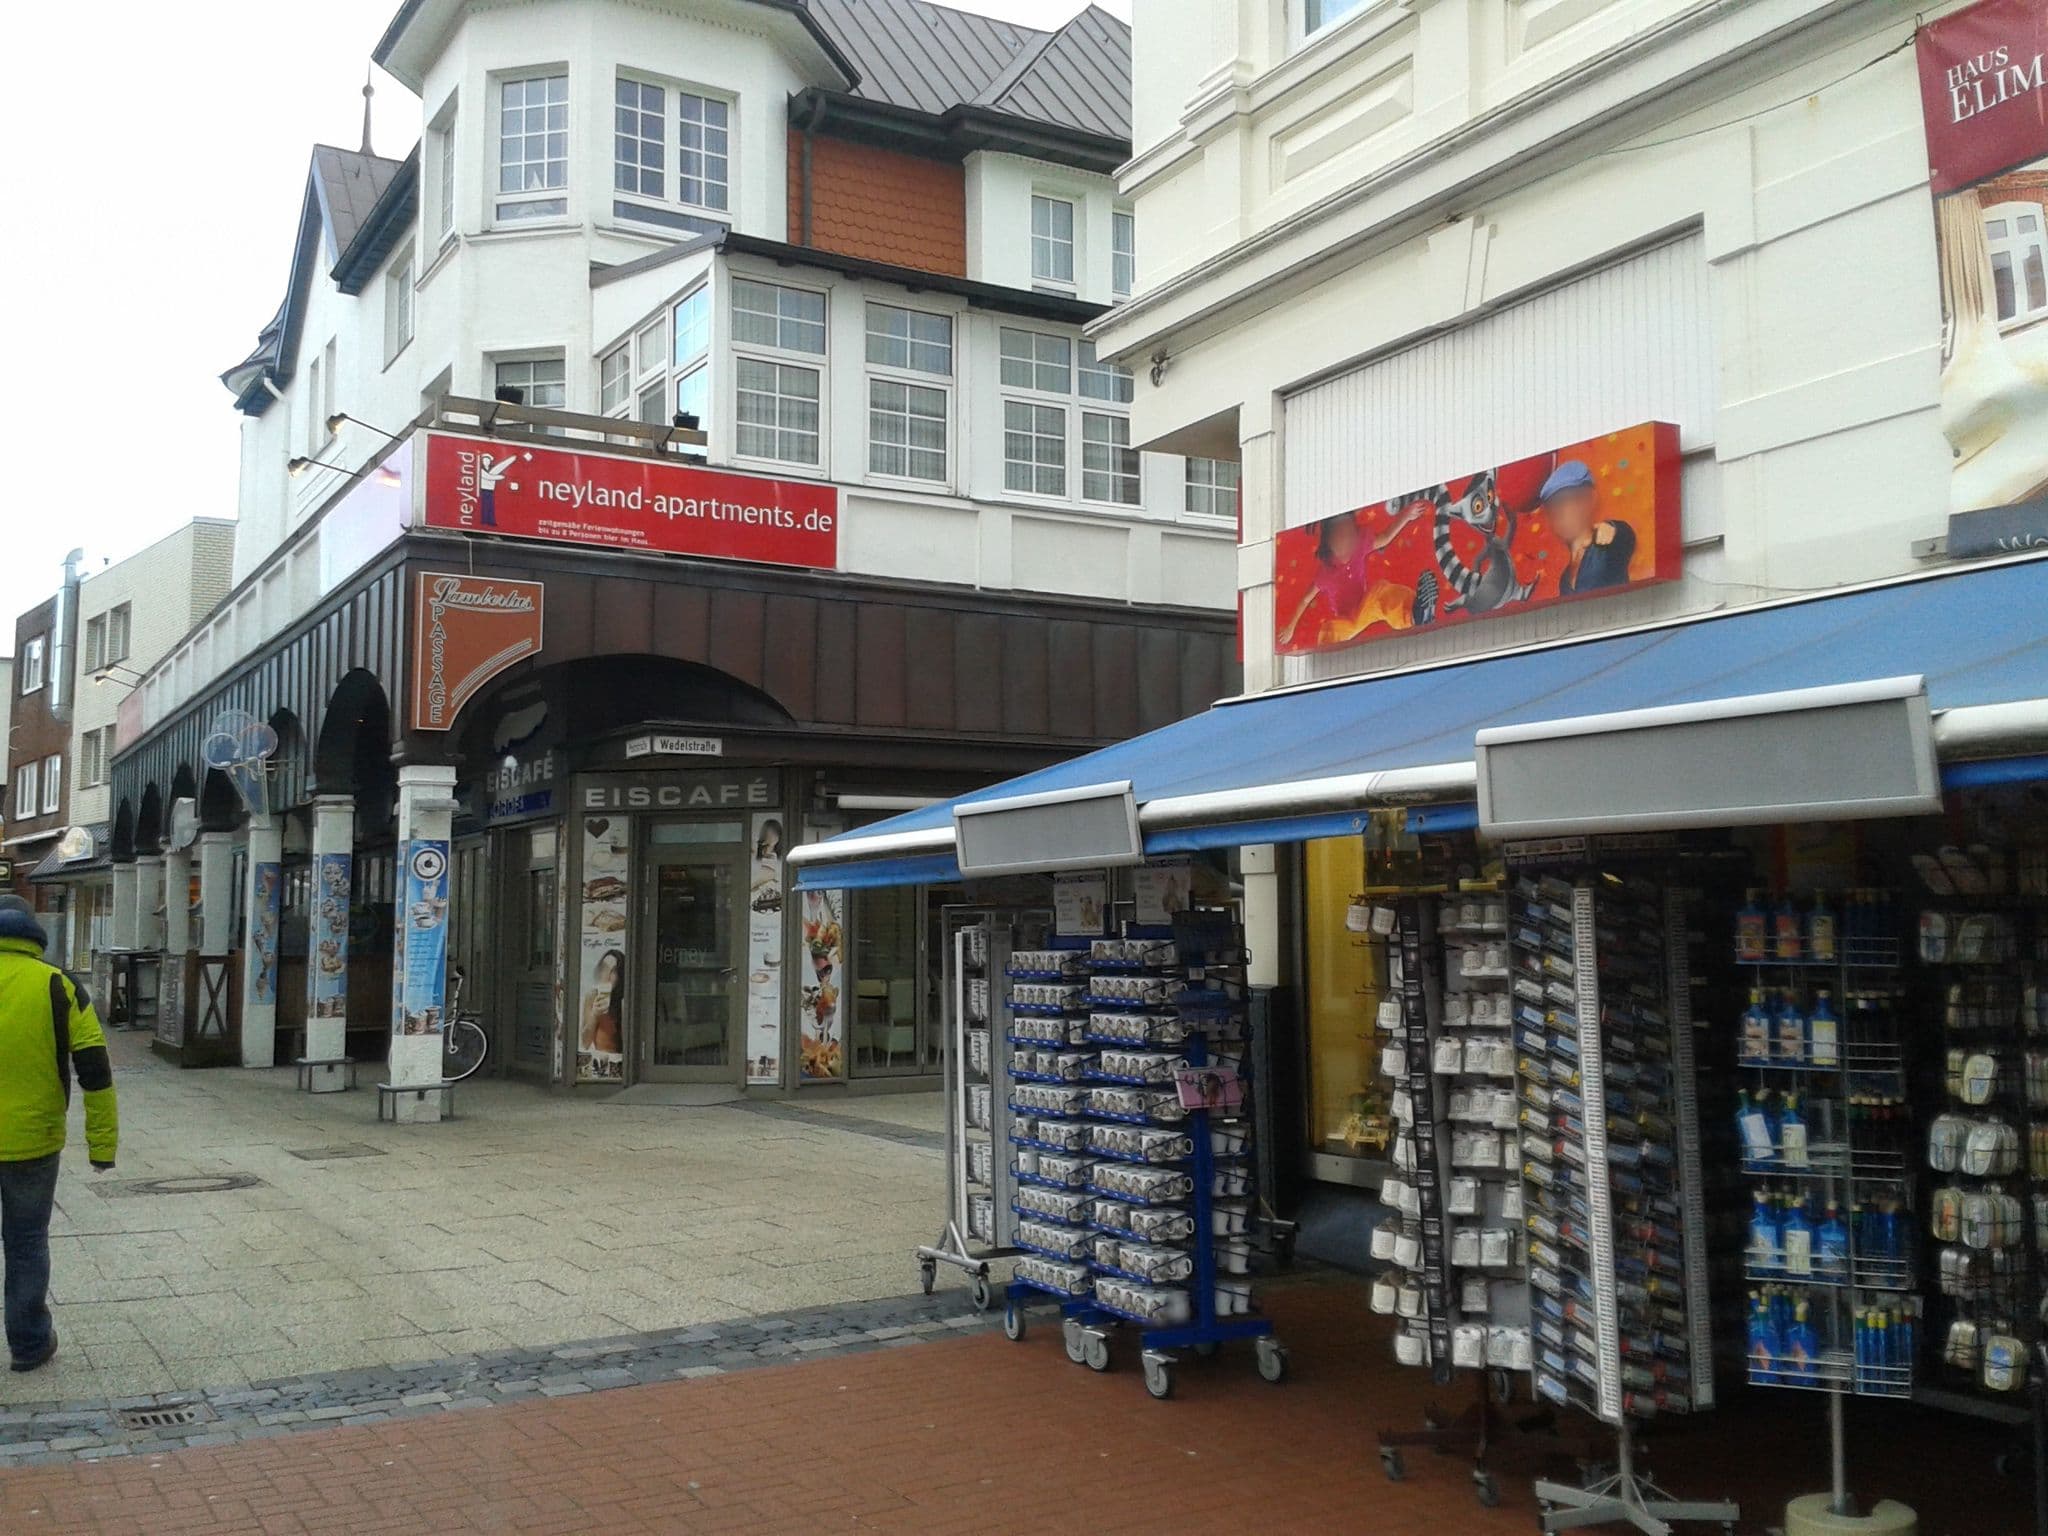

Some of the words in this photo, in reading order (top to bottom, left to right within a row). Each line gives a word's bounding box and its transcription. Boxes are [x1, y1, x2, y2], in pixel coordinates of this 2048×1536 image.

[1947, 46, 2009, 89] HAUS
[1949, 53, 2048, 124] ELIM
[456, 450, 477, 526] neyland
[538, 478, 832, 532] neyland-apartments.de
[569, 530, 602, 540] Personen
[583, 523, 645, 537] Ferienwohnungen
[428, 605, 447, 723] PASSAGE
[585, 777, 768, 808] EISCAFÉ
